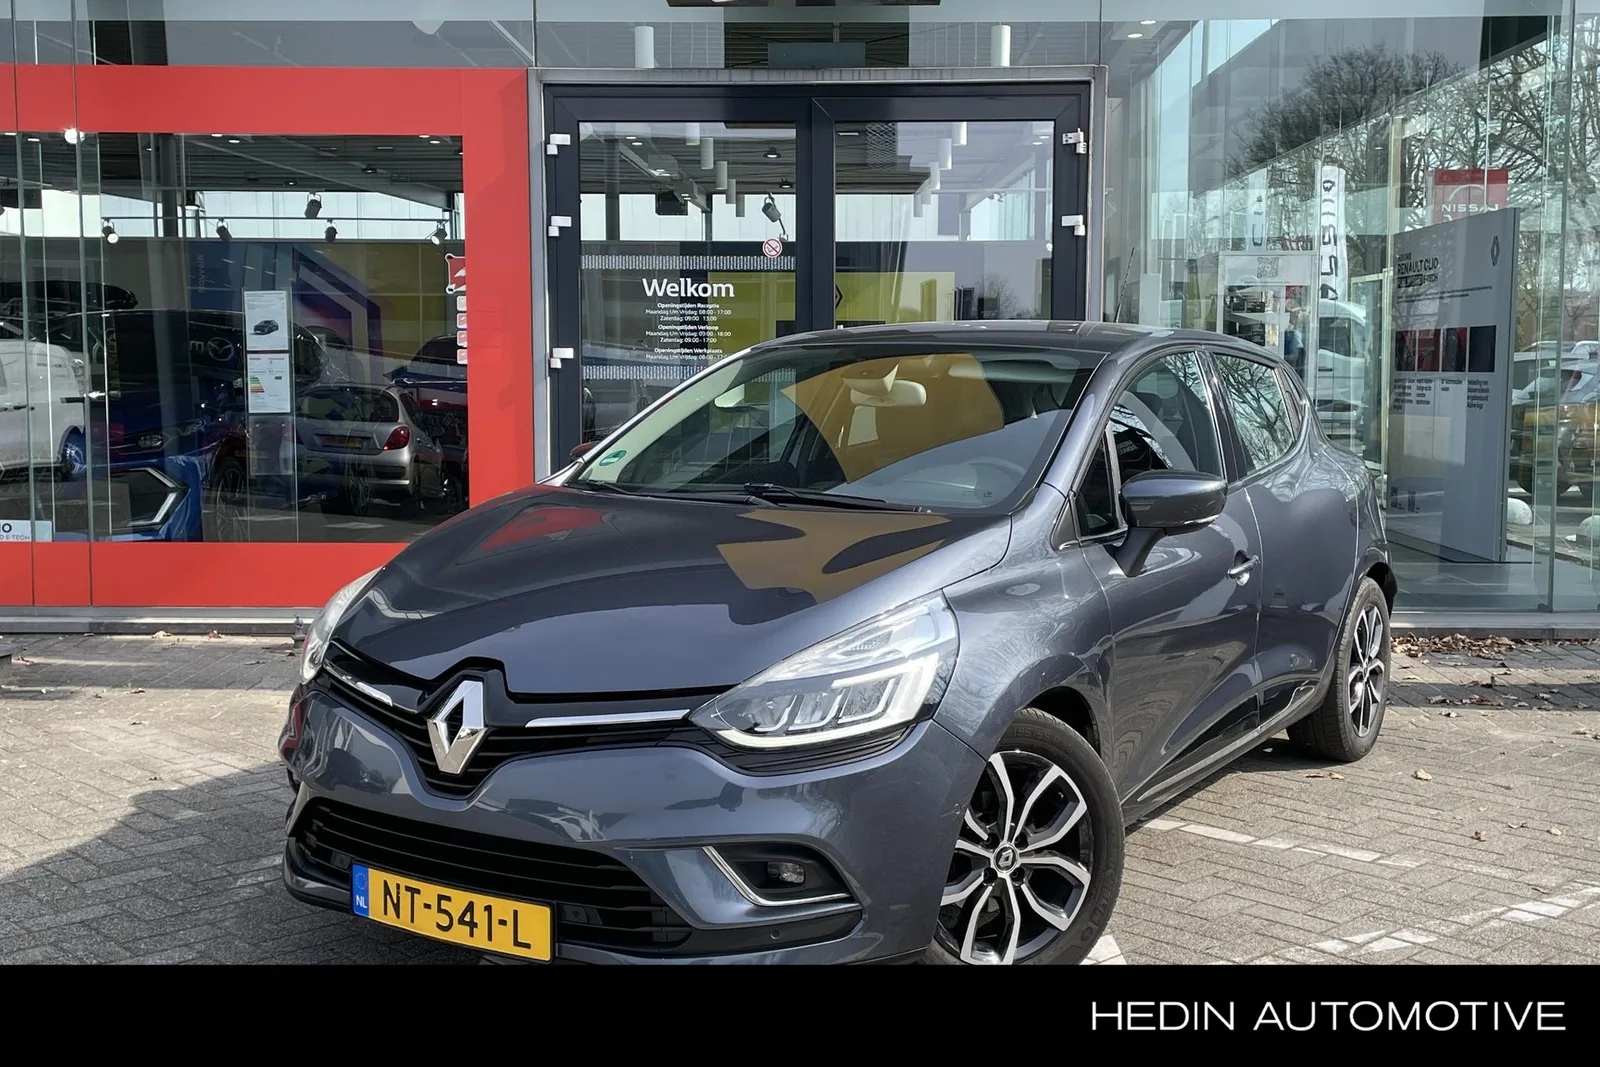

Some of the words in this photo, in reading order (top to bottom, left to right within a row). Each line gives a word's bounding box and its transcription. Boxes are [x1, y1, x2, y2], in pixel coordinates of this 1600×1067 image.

[642, 277, 735, 298] Welkom
[355, 895, 368, 909] NL
[382, 879, 532, 950] NT-541-L
